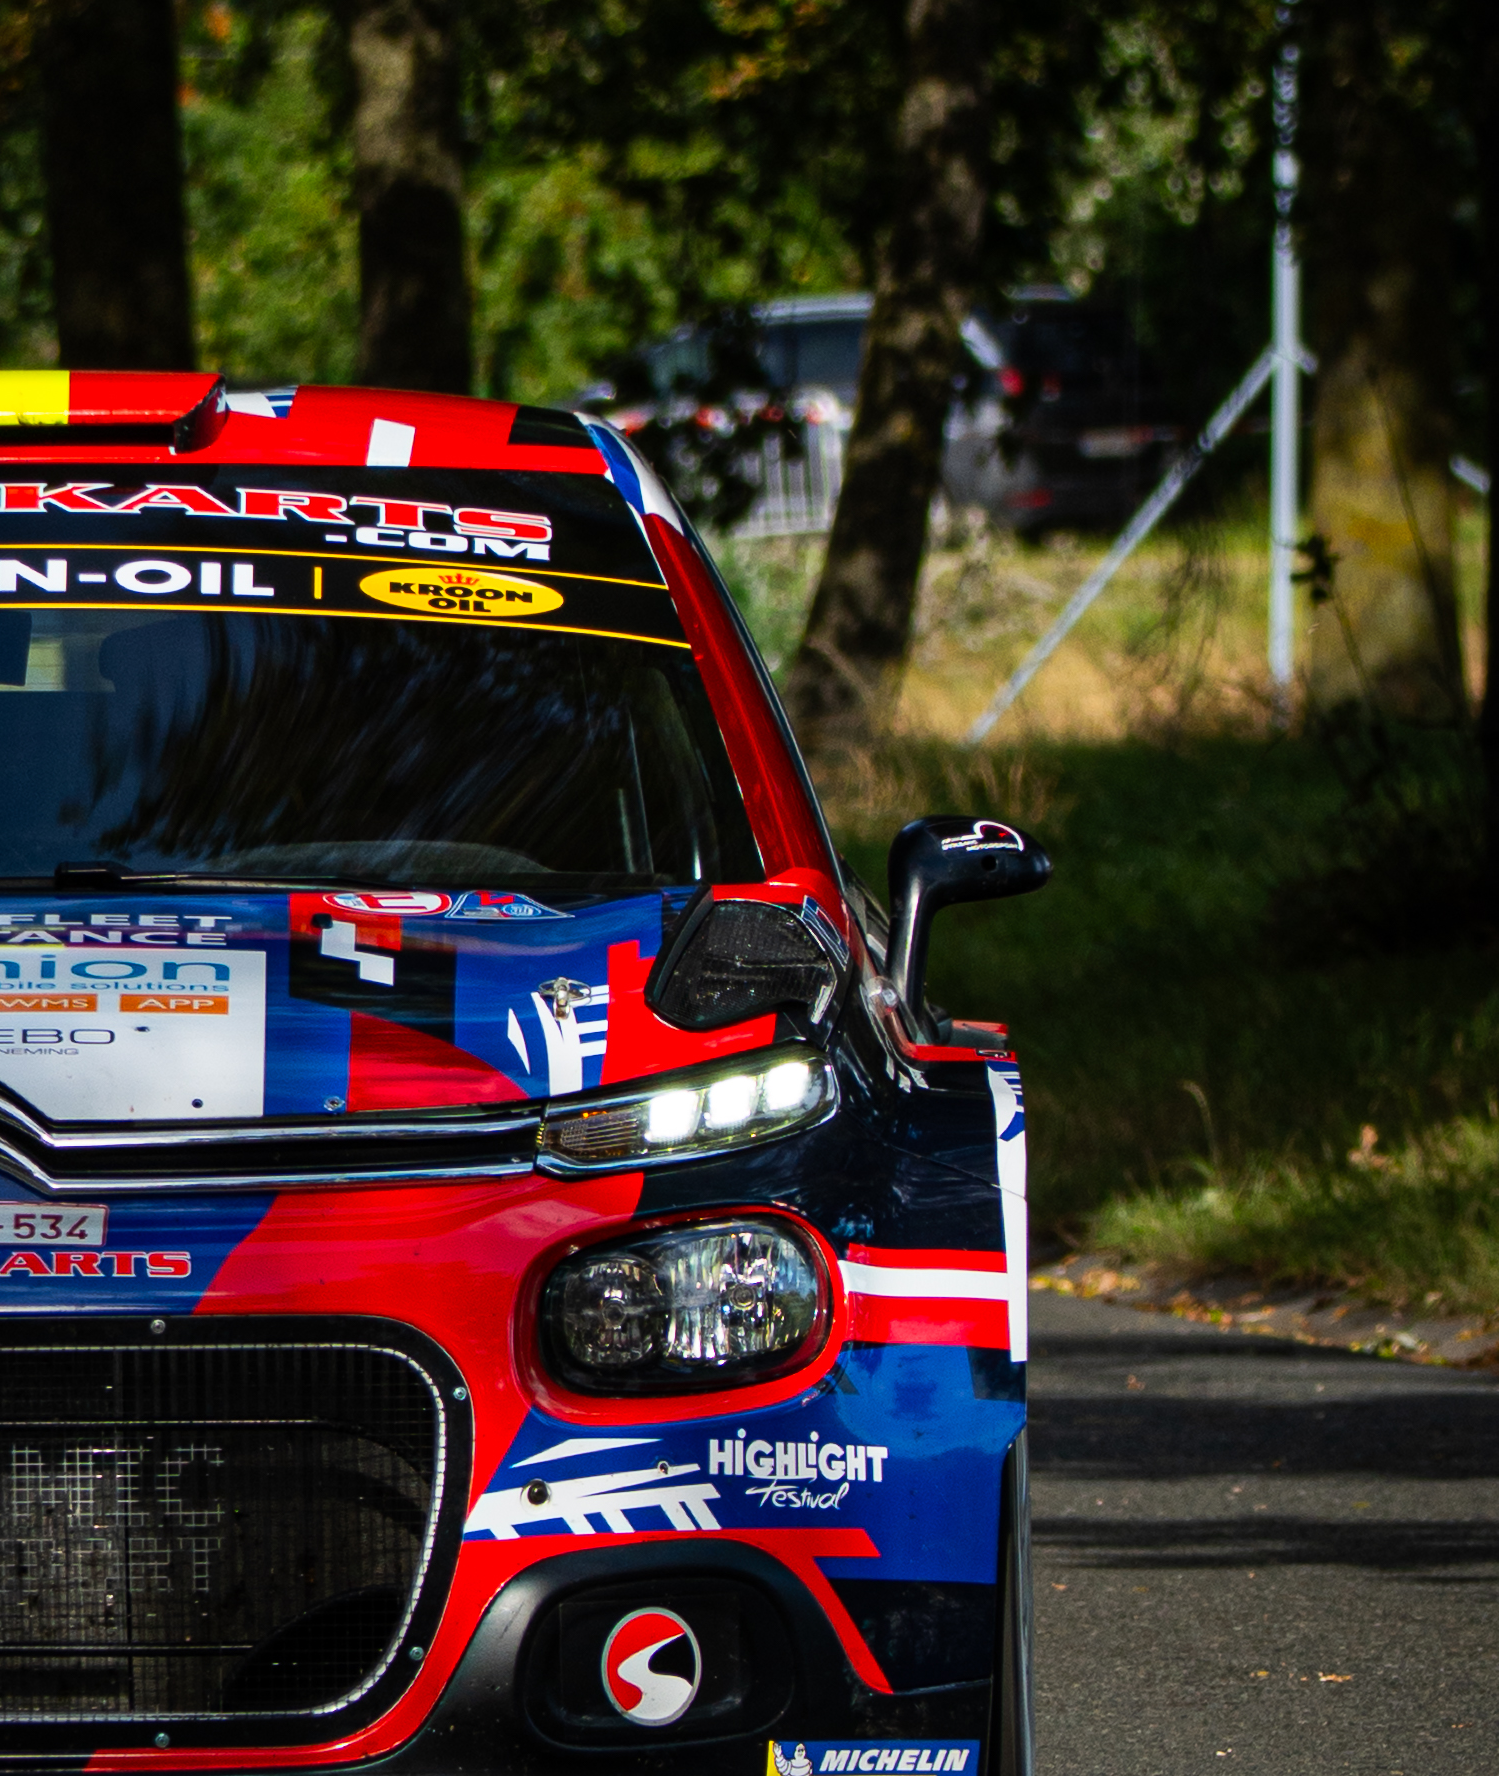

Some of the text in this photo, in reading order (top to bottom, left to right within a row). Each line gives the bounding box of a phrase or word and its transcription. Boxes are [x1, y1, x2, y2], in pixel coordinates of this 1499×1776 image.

[325, 526, 552, 562] .COM
[388, 581, 533, 604] KROON
[427, 596, 493, 614] OIL
[70, 980, 230, 992] solutions
[137, 998, 215, 1010] APP
[819, 1749, 970, 1772] MICHELIN
